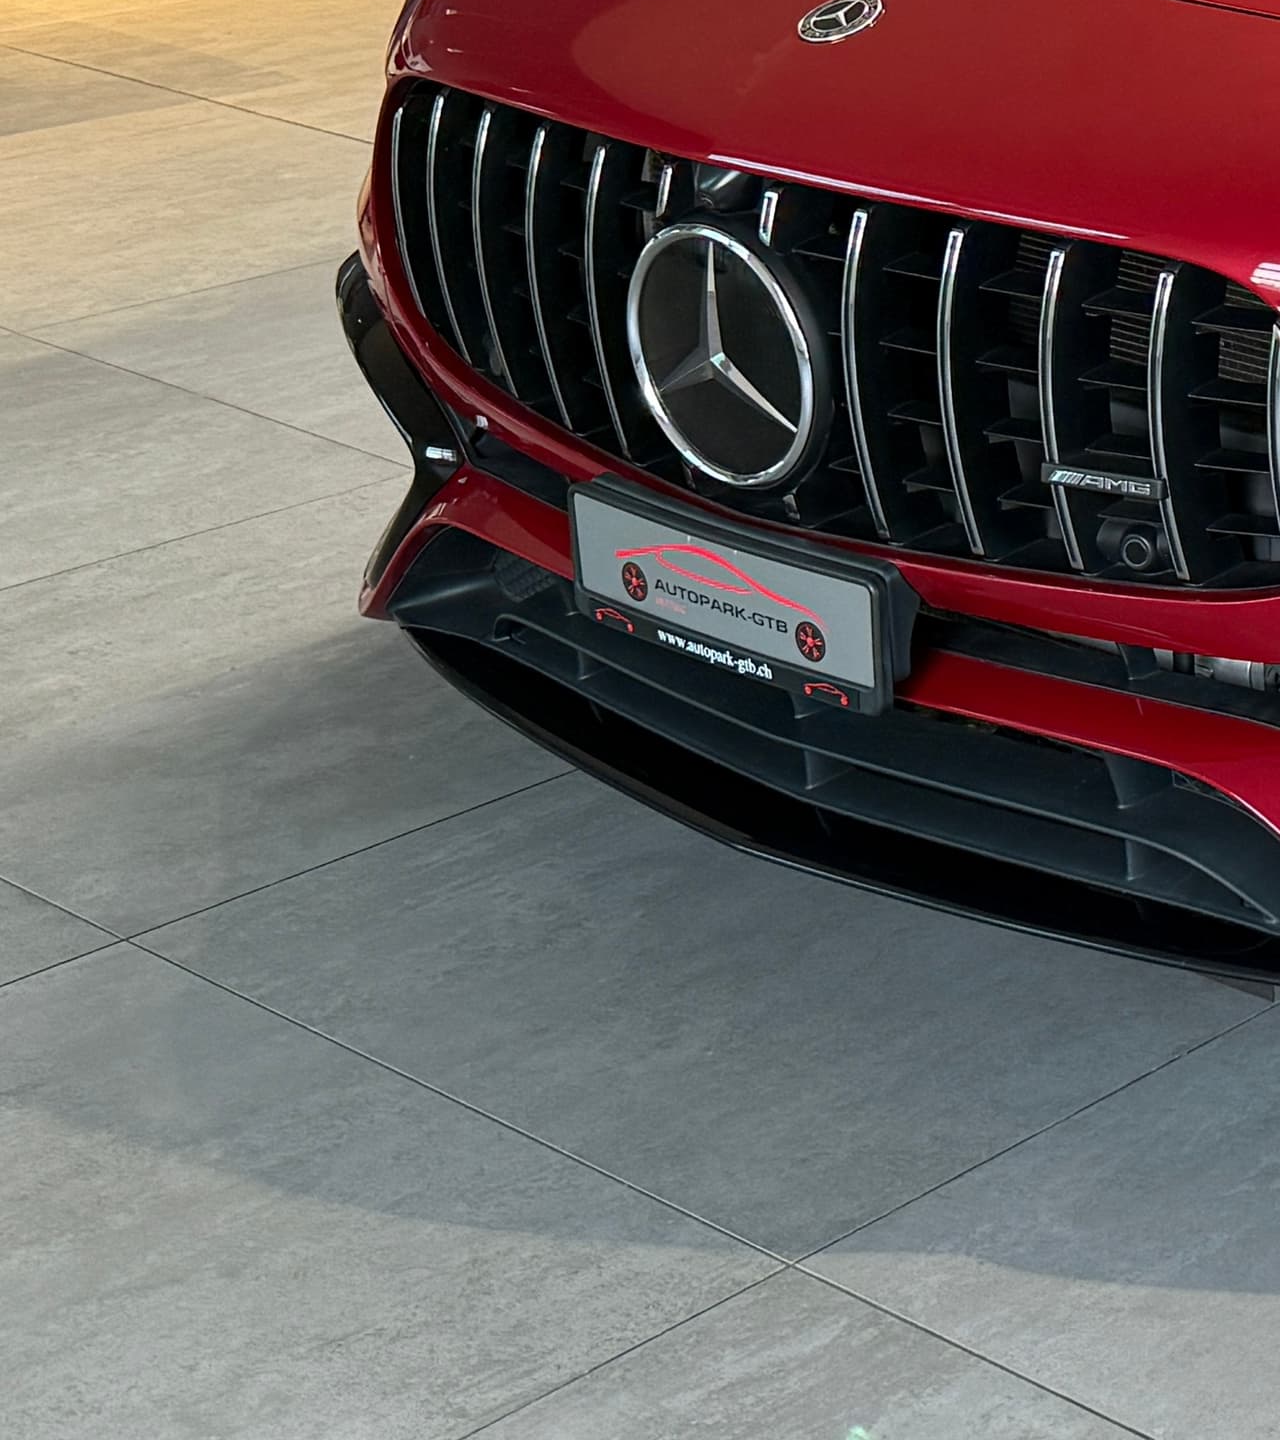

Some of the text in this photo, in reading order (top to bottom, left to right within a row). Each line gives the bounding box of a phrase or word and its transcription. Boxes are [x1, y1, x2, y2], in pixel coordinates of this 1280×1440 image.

[1081, 474, 1151, 496] AMG
[655, 578, 788, 634] AUTOPARK-GTB
[657, 629, 773, 680] www.autopark-gtb.ch
